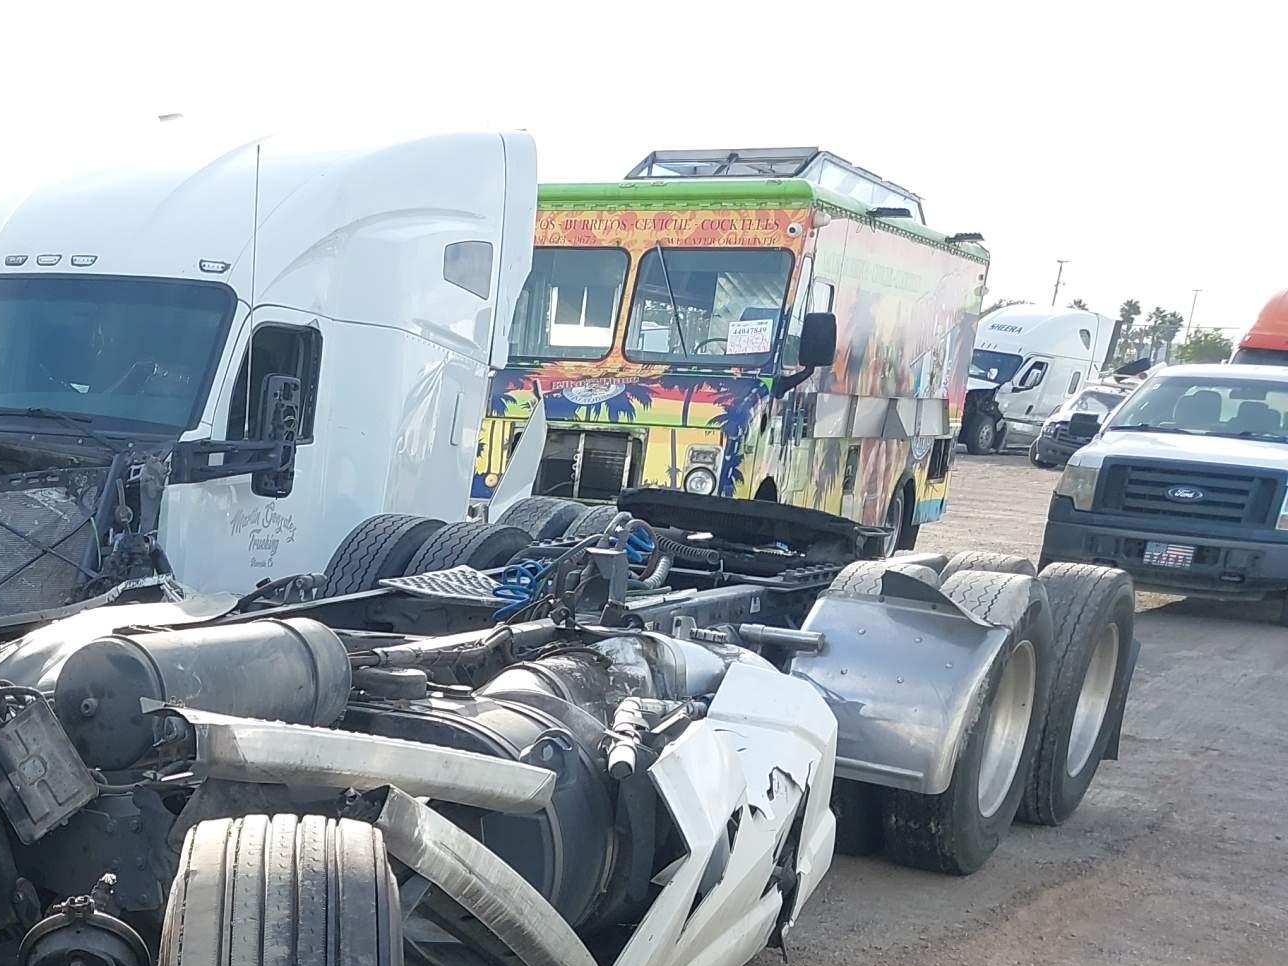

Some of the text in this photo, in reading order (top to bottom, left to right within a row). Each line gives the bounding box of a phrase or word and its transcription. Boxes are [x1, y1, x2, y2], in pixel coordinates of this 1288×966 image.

[564, 218, 626, 231] BURRITOS
[634, 218, 692, 231] CEVICHE
[700, 218, 781, 231] COCKTELES
[988, 323, 1023, 334] SHEERA
[1174, 489, 1196, 498] Ford
[248, 528, 280, 557] Trucking
